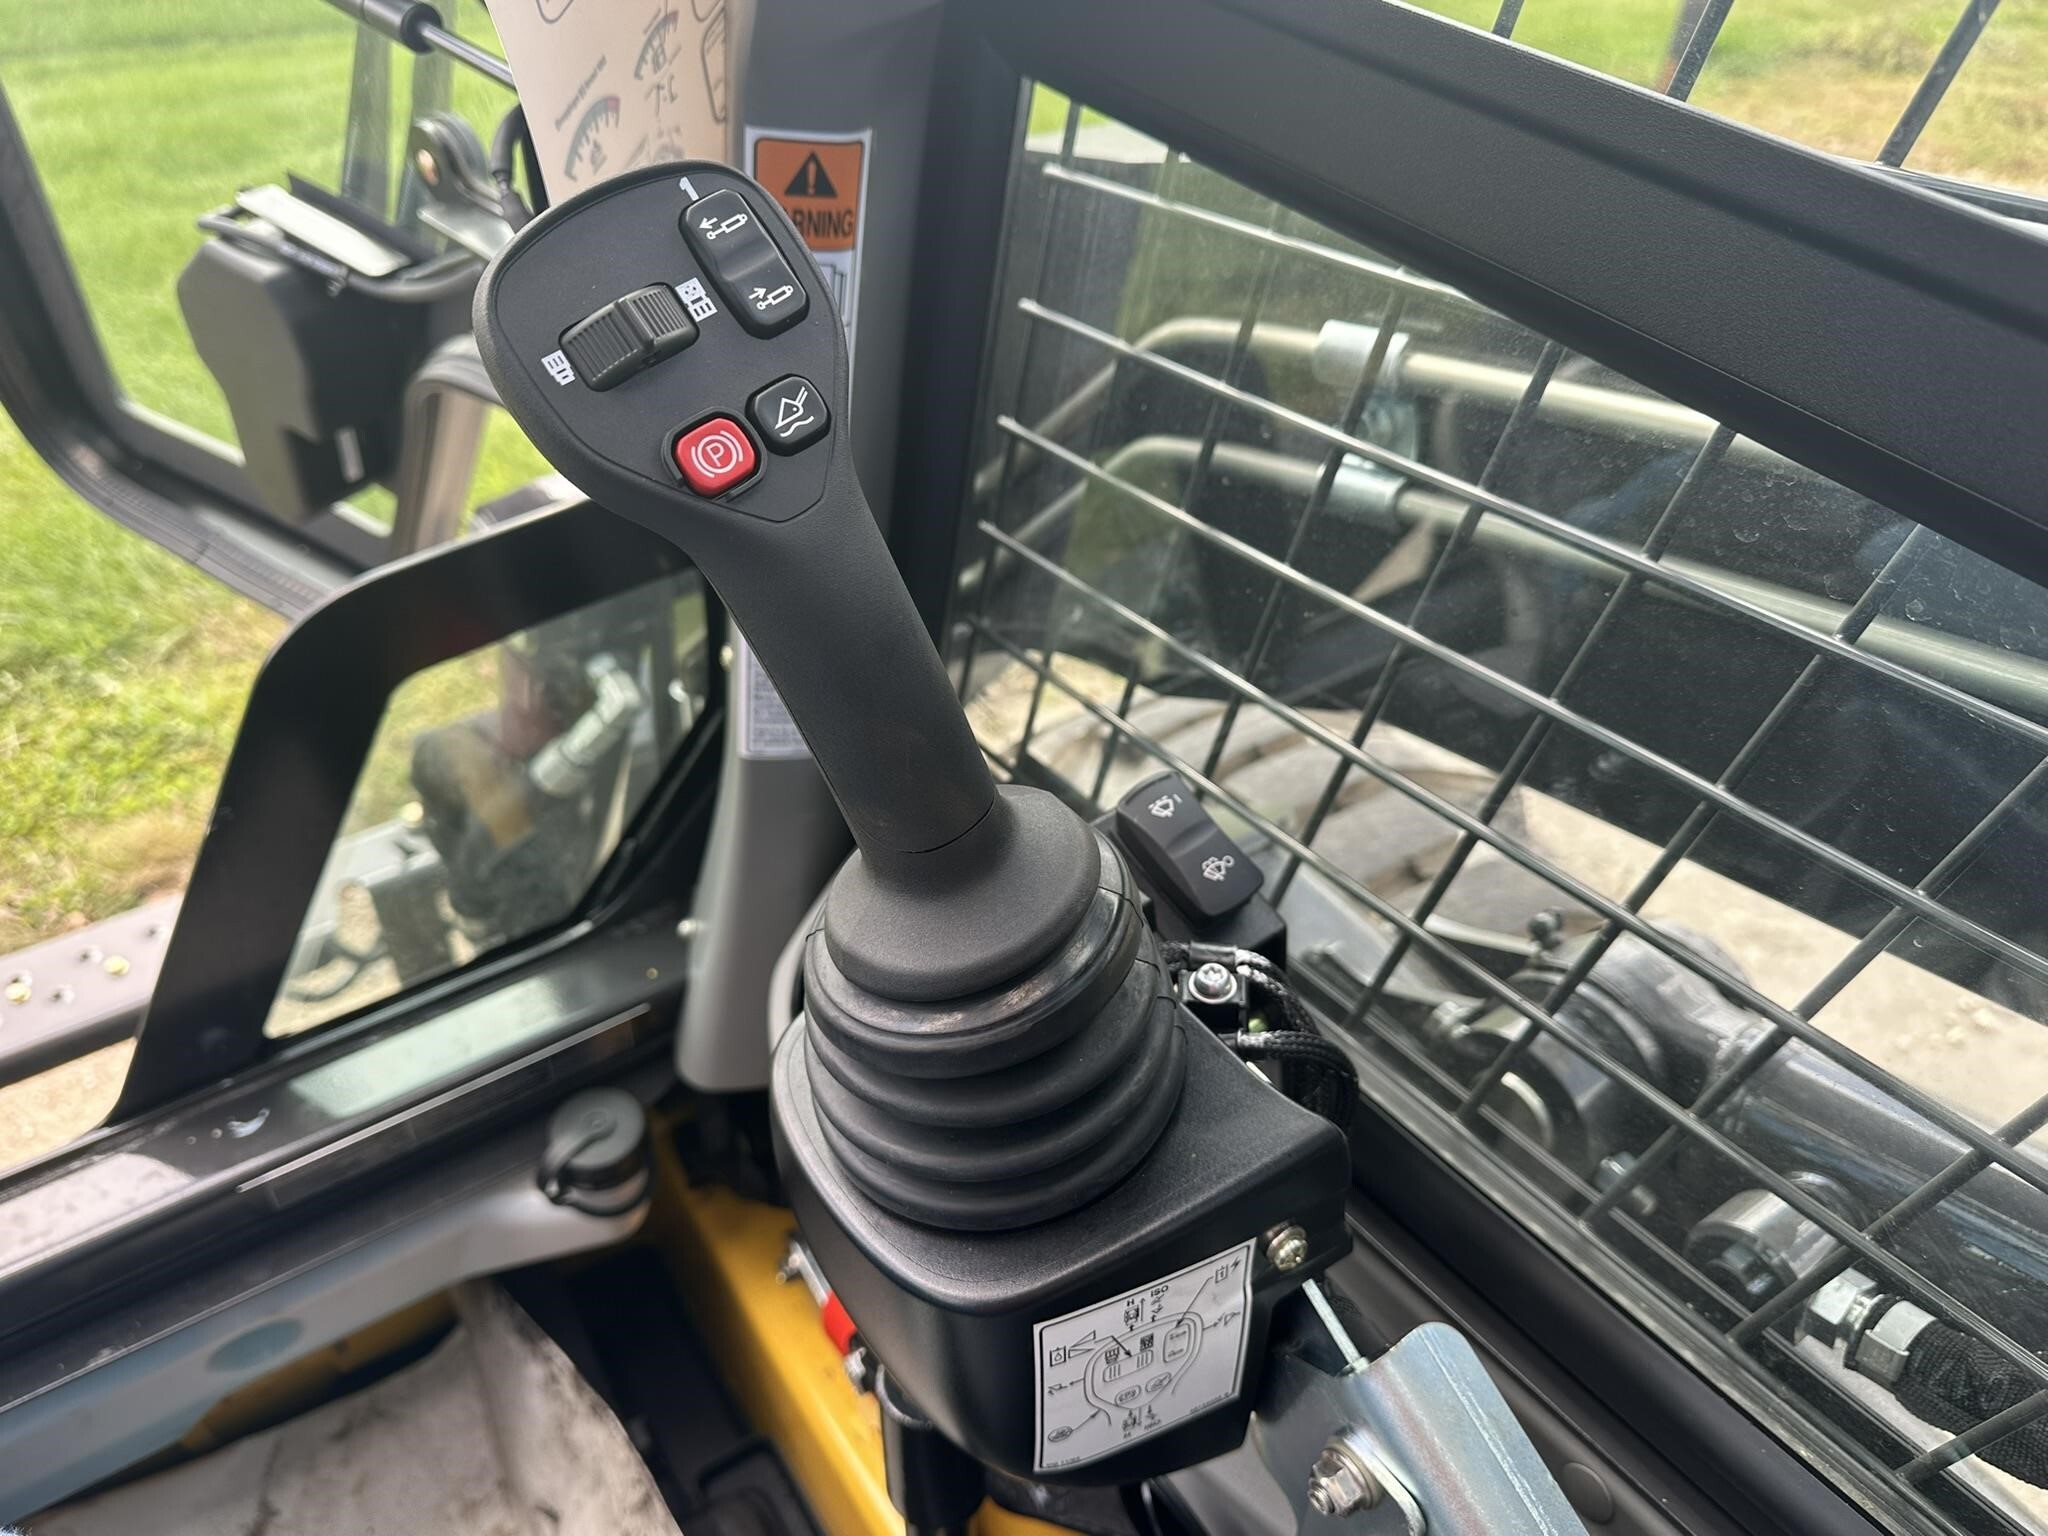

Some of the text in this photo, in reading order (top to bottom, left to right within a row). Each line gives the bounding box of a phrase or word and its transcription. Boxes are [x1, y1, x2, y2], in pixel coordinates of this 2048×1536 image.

[679, 176, 699, 200] 1
[790, 208, 855, 238] RNING
[705, 442, 726, 467] P
[1150, 1284, 1169, 1297] ISO
